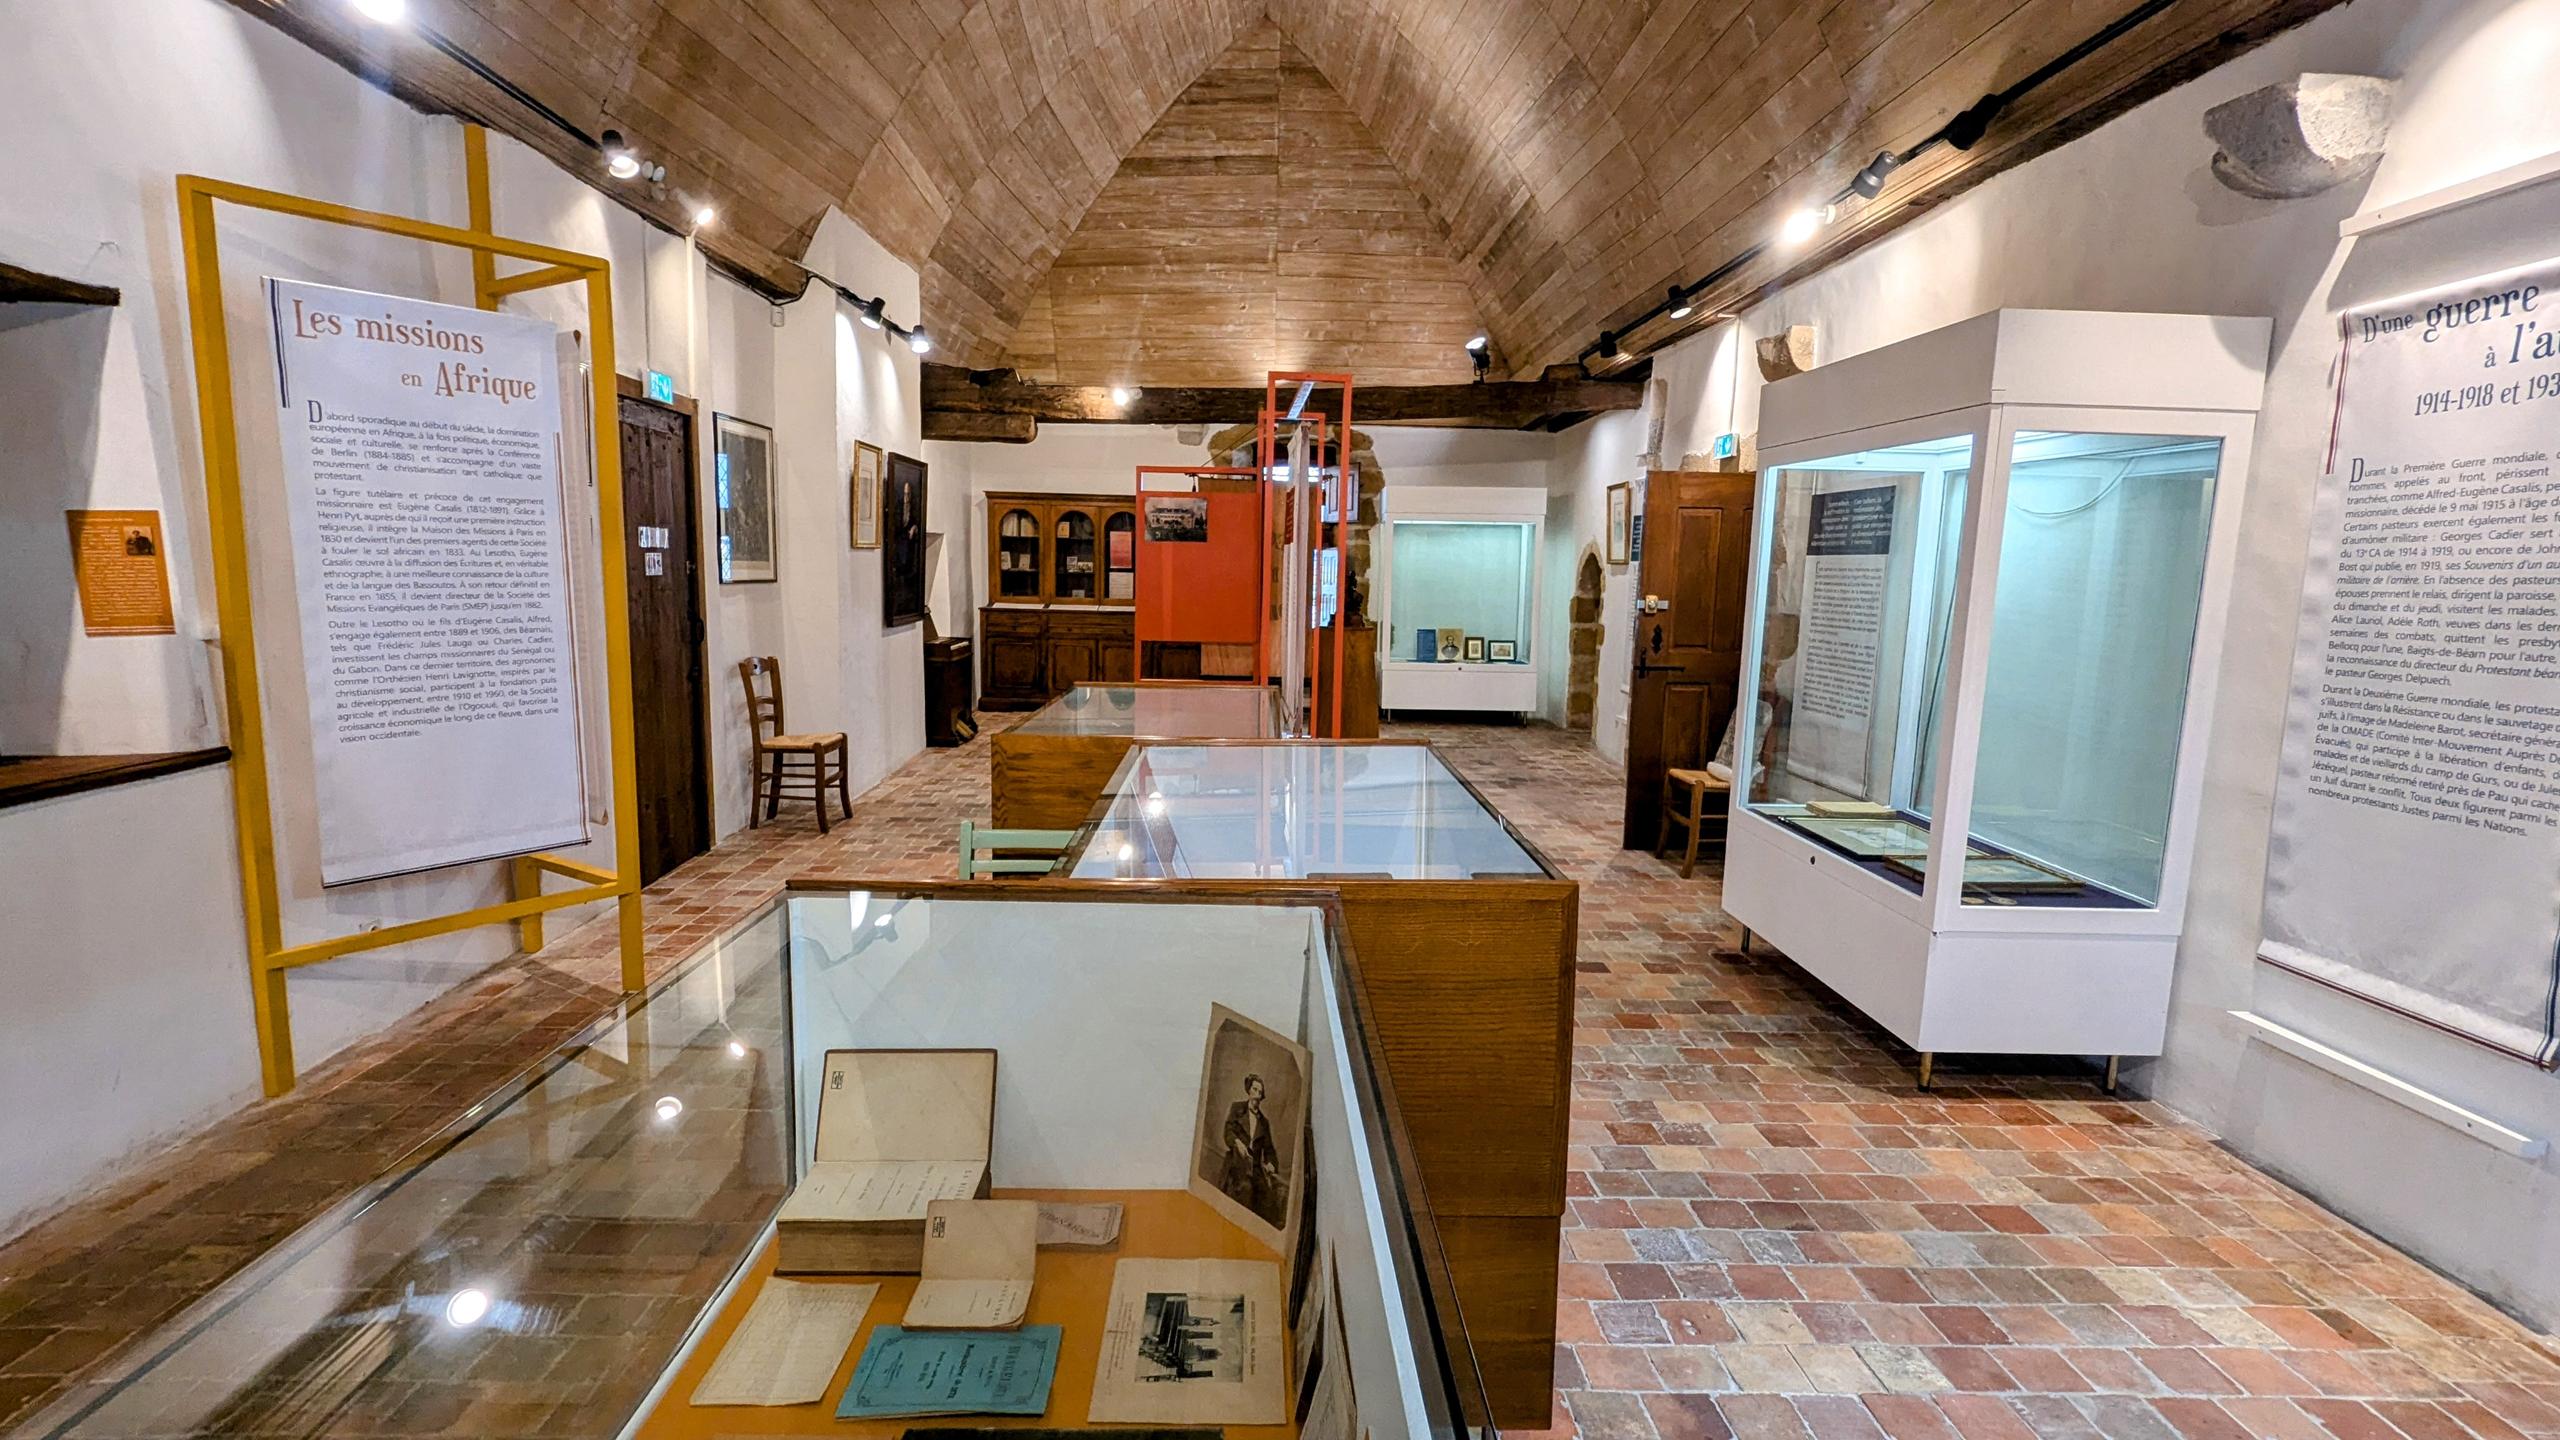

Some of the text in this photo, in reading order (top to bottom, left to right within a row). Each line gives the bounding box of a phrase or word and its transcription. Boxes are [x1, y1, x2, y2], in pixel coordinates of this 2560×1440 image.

[293, 299, 484, 355] Les missions
[2363, 285, 2539, 343] D'une guerre
[2484, 320, 2560, 368] à l'a
[401, 361, 537, 404] en Afrique
[2414, 383, 2494, 416] 1914-1918
[2500, 380, 2521, 405] et
